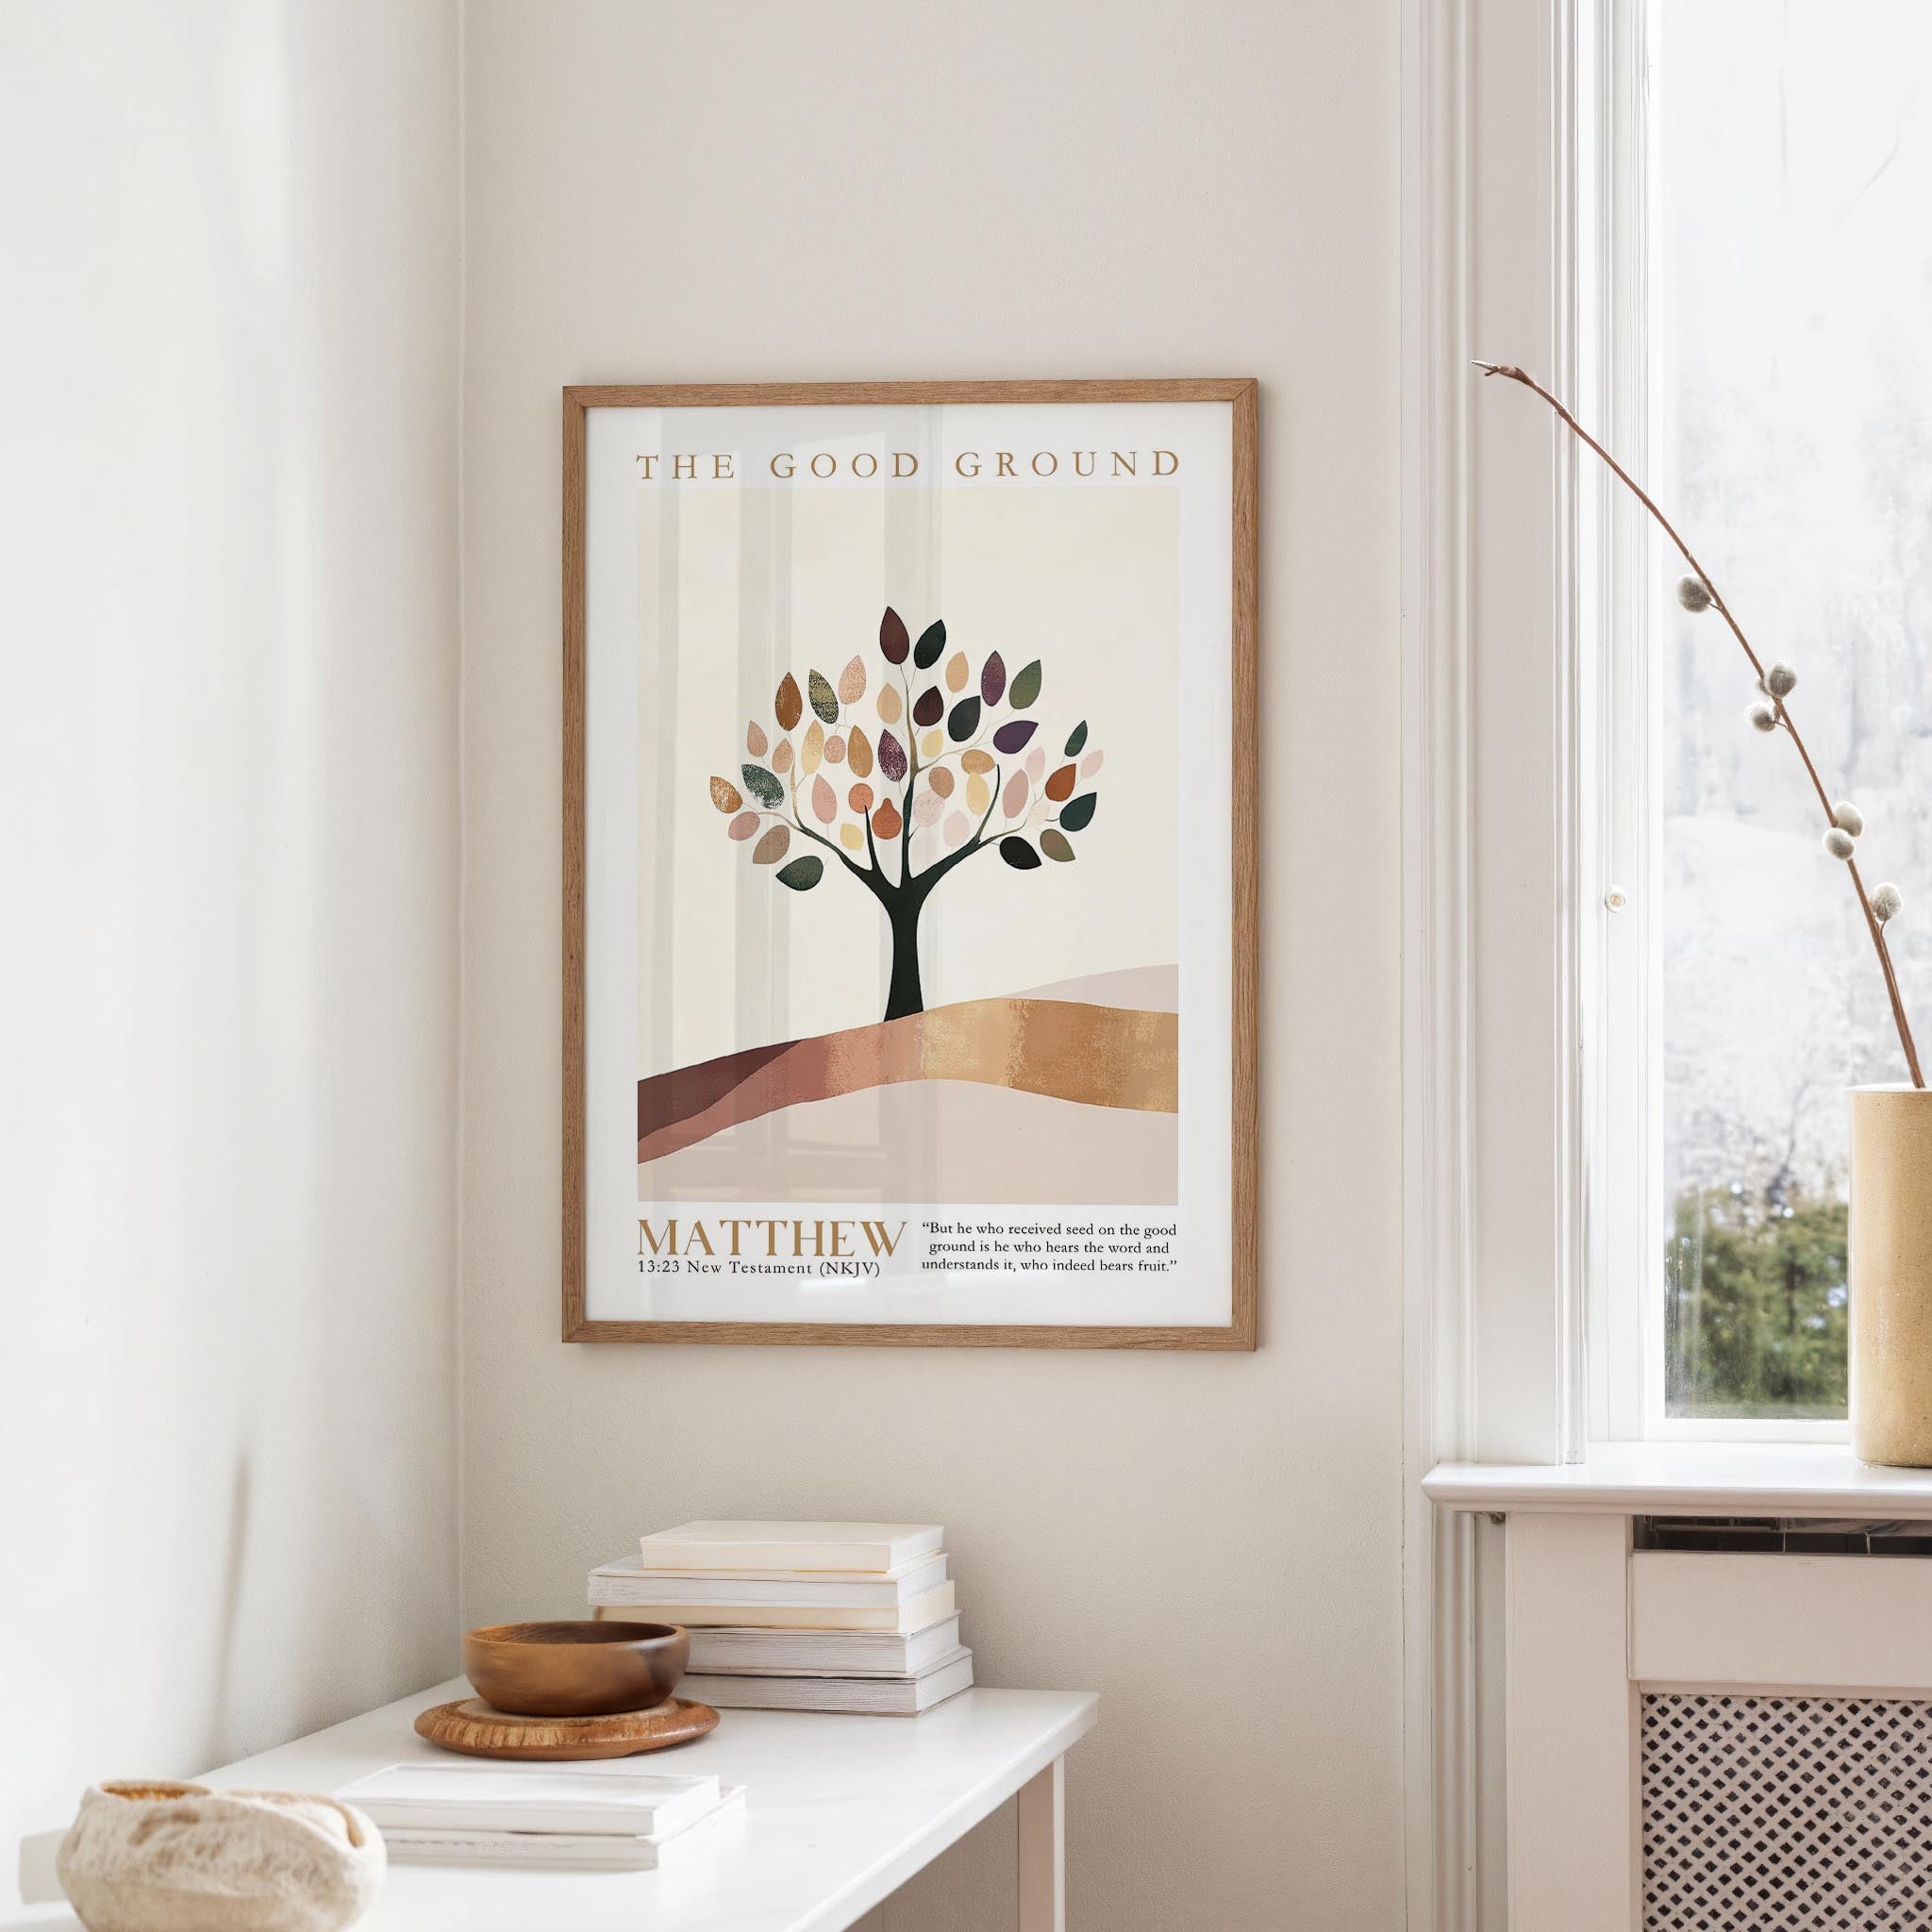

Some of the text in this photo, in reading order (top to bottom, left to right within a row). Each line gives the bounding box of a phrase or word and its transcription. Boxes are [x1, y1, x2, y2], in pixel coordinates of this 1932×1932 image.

[635, 450, 1179, 480] THE GOOD GROUND
[637, 1219, 908, 1257] MATTHEW
[922, 1221, 1177, 1240] “But he who received seed on the good
[928, 1240, 1170, 1257] ground is he who hears the word and
[638, 1259, 880, 1279] 13:23 New Testament (NKJV)
[921, 1257, 1177, 1274] understands it, who indeed bears fruit.”
